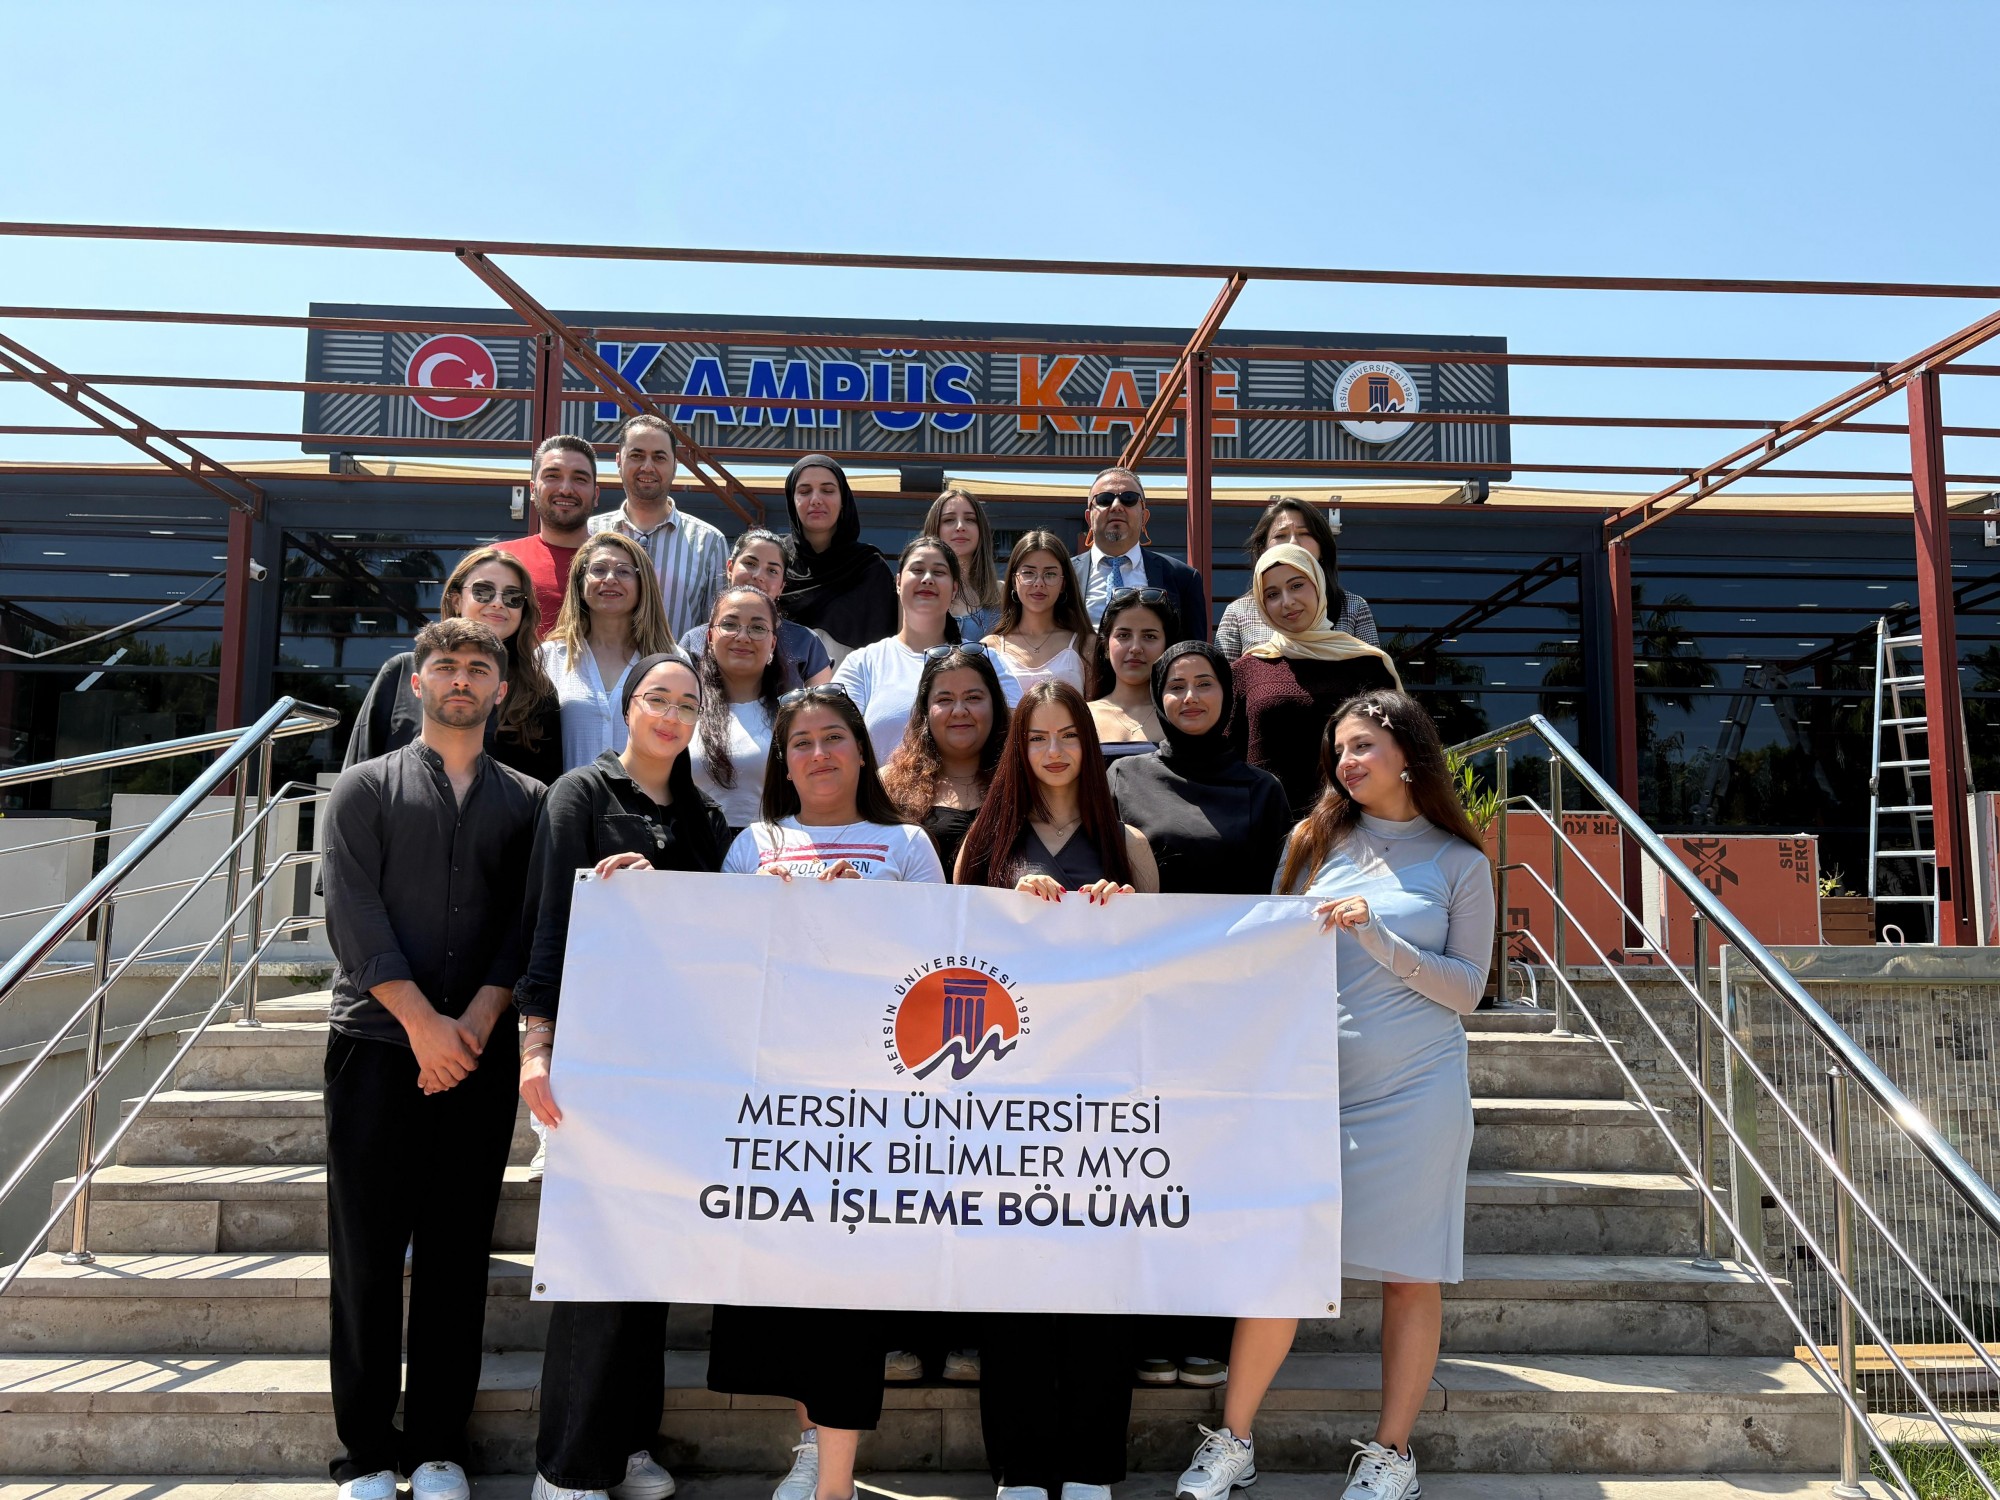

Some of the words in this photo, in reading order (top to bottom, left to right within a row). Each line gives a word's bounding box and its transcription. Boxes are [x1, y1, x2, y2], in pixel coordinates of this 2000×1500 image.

[595, 342, 976, 433] KAMPÜS
[1344, 364, 1404, 385] ÜNİVERSİTESİ
[1402, 383, 1414, 402] 1992
[1340, 386, 1349, 413] ERSİN
[894, 955, 1017, 996] ÜNİVERSİTESİ
[1015, 996, 1031, 1035] 1992
[883, 1004, 906, 1075] MERSİN
[737, 1088, 888, 1129] MERSİN
[903, 1090, 1160, 1134] ÜNİVERSİTESİ
[724, 1133, 874, 1174] TEKNİK
[888, 1134, 1065, 1178] BİLİMLER
[1077, 1145, 1171, 1179] MYO
[699, 1184, 815, 1222] GIDA
[829, 1178, 984, 1235] İŞLEME
[998, 1183, 1190, 1229] BÖLÜMÜ
